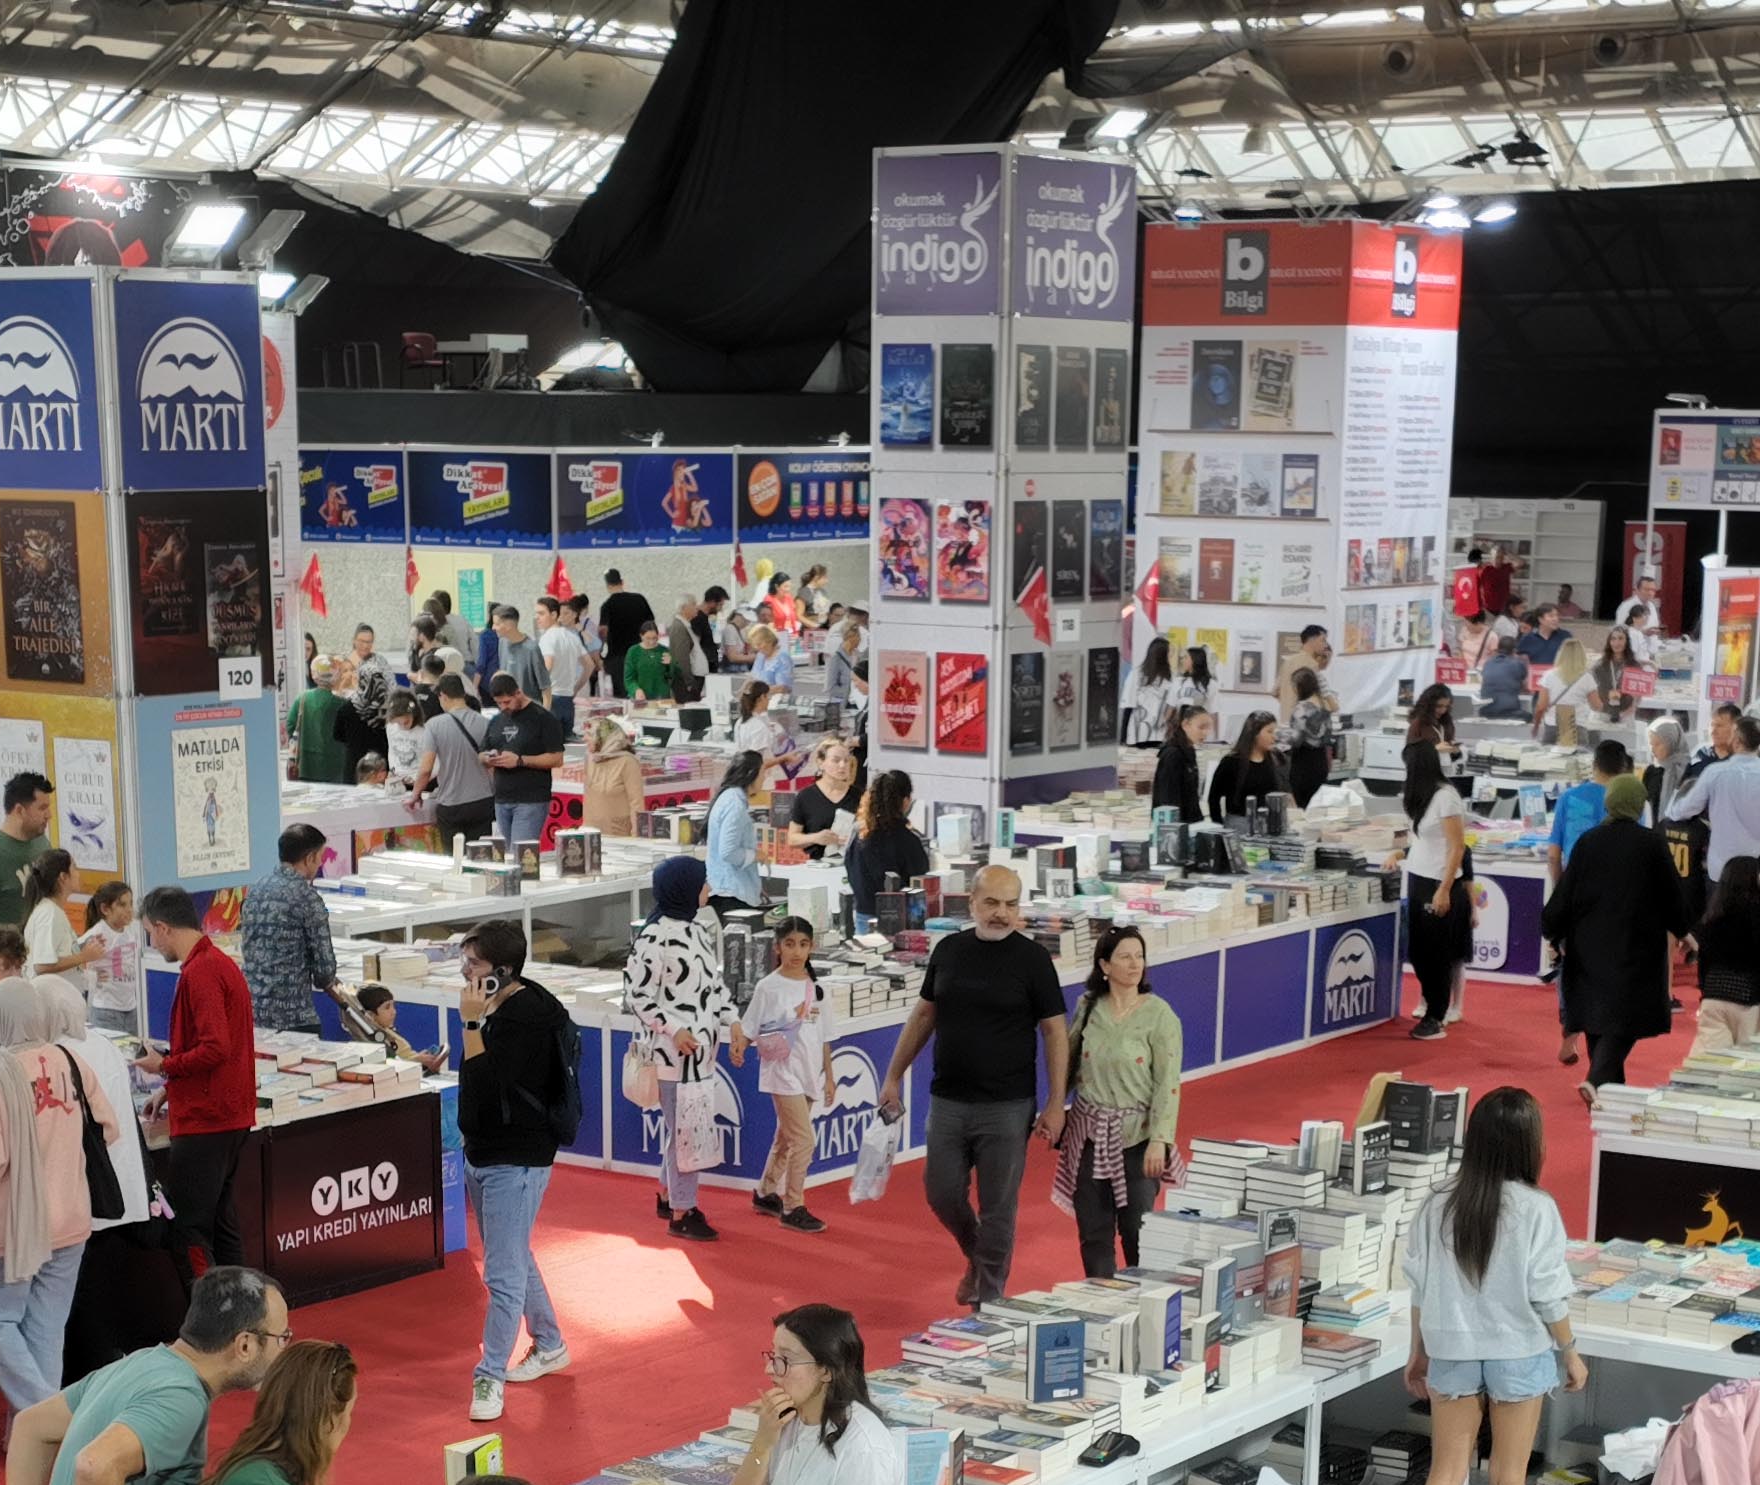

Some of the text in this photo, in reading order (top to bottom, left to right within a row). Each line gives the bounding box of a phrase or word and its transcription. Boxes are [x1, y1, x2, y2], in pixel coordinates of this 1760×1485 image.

[894, 192, 945, 207] okumak
[1038, 182, 1084, 203] okumak
[882, 212, 957, 231] özgürlüktür
[881, 233, 983, 283] indigo
[1025, 235, 1114, 305] indigo
[1224, 291, 1264, 312] Bilgi
[1392, 292, 1416, 316] Bilgi
[140, 402, 248, 451] MARTI
[445, 467, 485, 479] Dikkat
[227, 670, 254, 686] 120
[64, 773, 104, 788] GURUR
[1323, 981, 1377, 1026] MARTI
[642, 1113, 743, 1167] MTI
[813, 1105, 882, 1161] MART
[277, 1196, 433, 1252] YAPI KREDİ YAYINLARI
